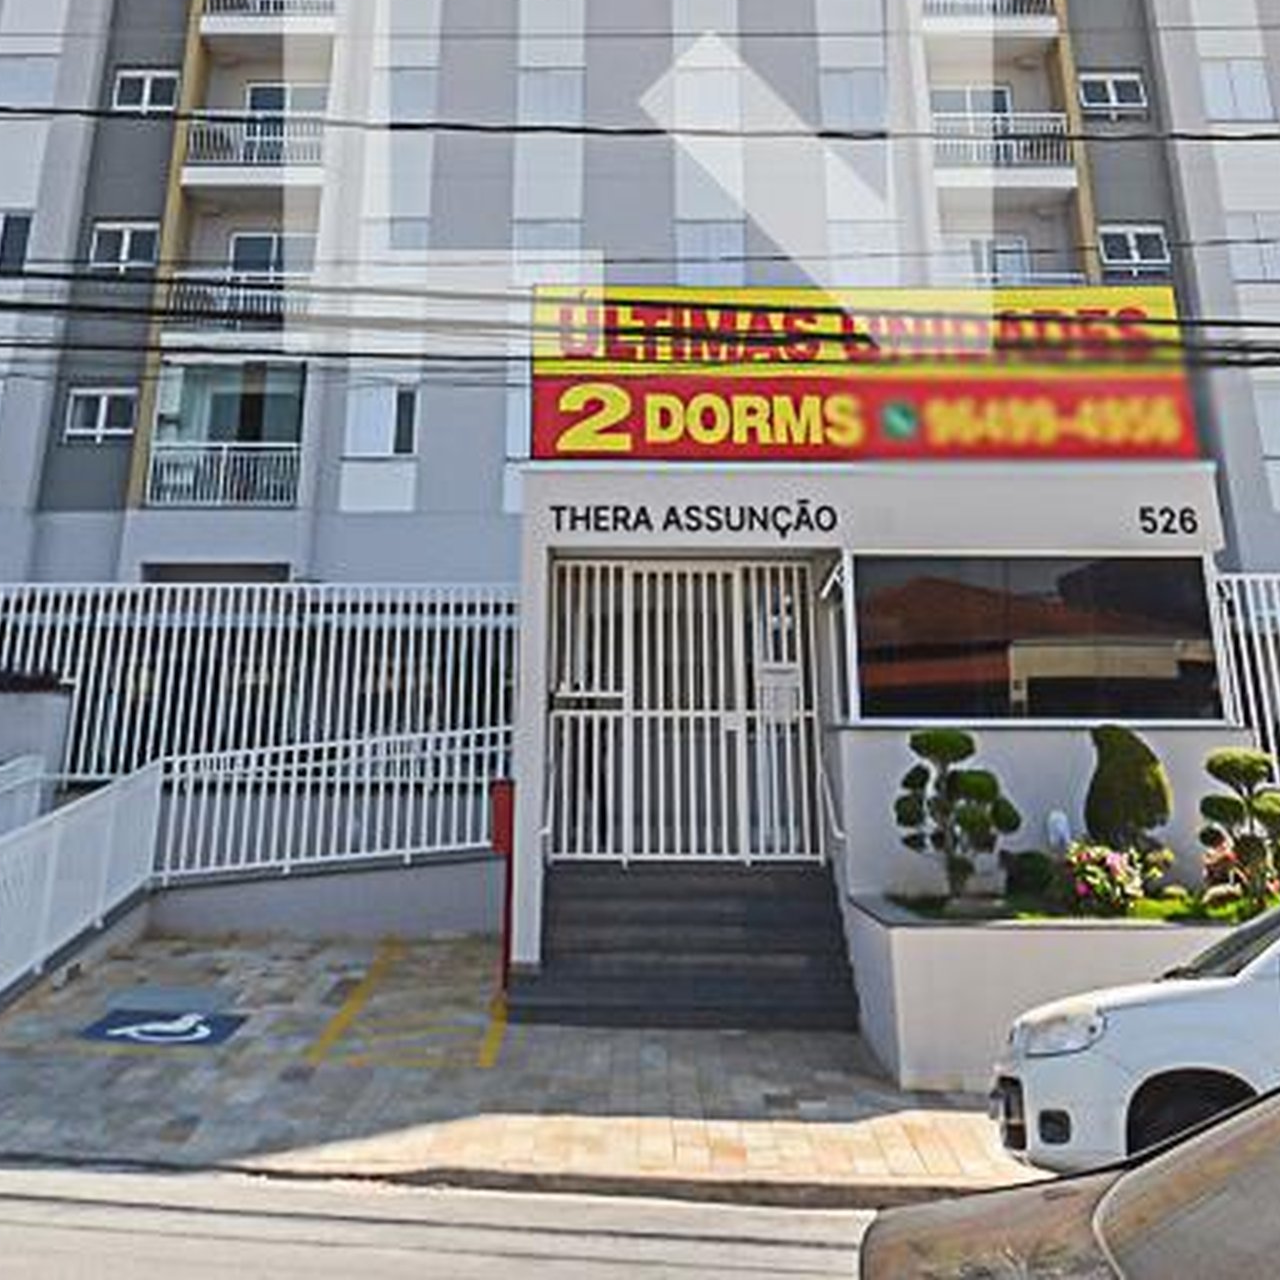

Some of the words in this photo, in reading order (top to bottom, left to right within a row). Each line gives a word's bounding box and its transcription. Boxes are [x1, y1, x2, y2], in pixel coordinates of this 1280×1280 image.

[556, 383, 631, 451] 2
[645, 392, 863, 446] DORMS
[550, 506, 654, 533] THERA
[663, 498, 838, 539] ASSUNÇÃO
[1138, 509, 1199, 535] 526
